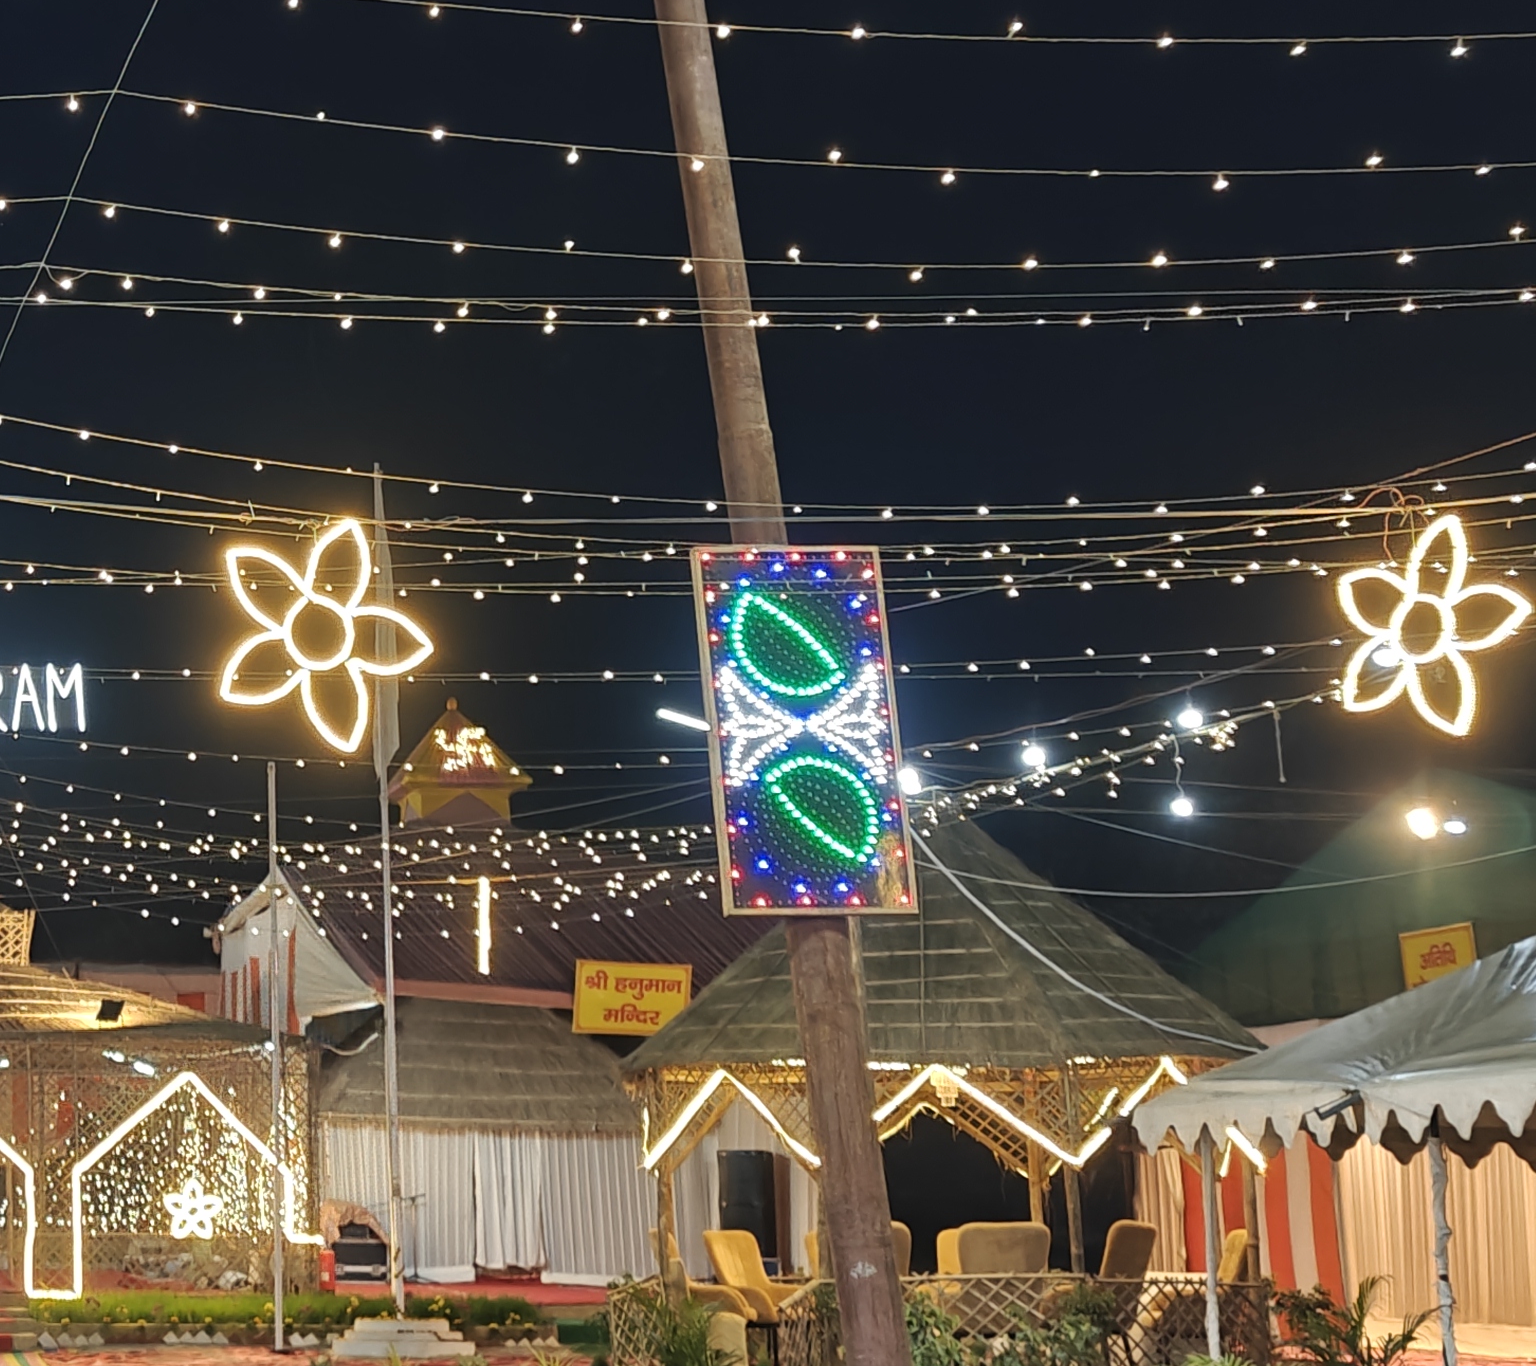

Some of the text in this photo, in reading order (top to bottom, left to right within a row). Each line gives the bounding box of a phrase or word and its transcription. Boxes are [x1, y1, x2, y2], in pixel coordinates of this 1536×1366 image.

[584, 969, 683, 1001] श्री हनुमान
[602, 1003, 661, 1026] मन्दिर
